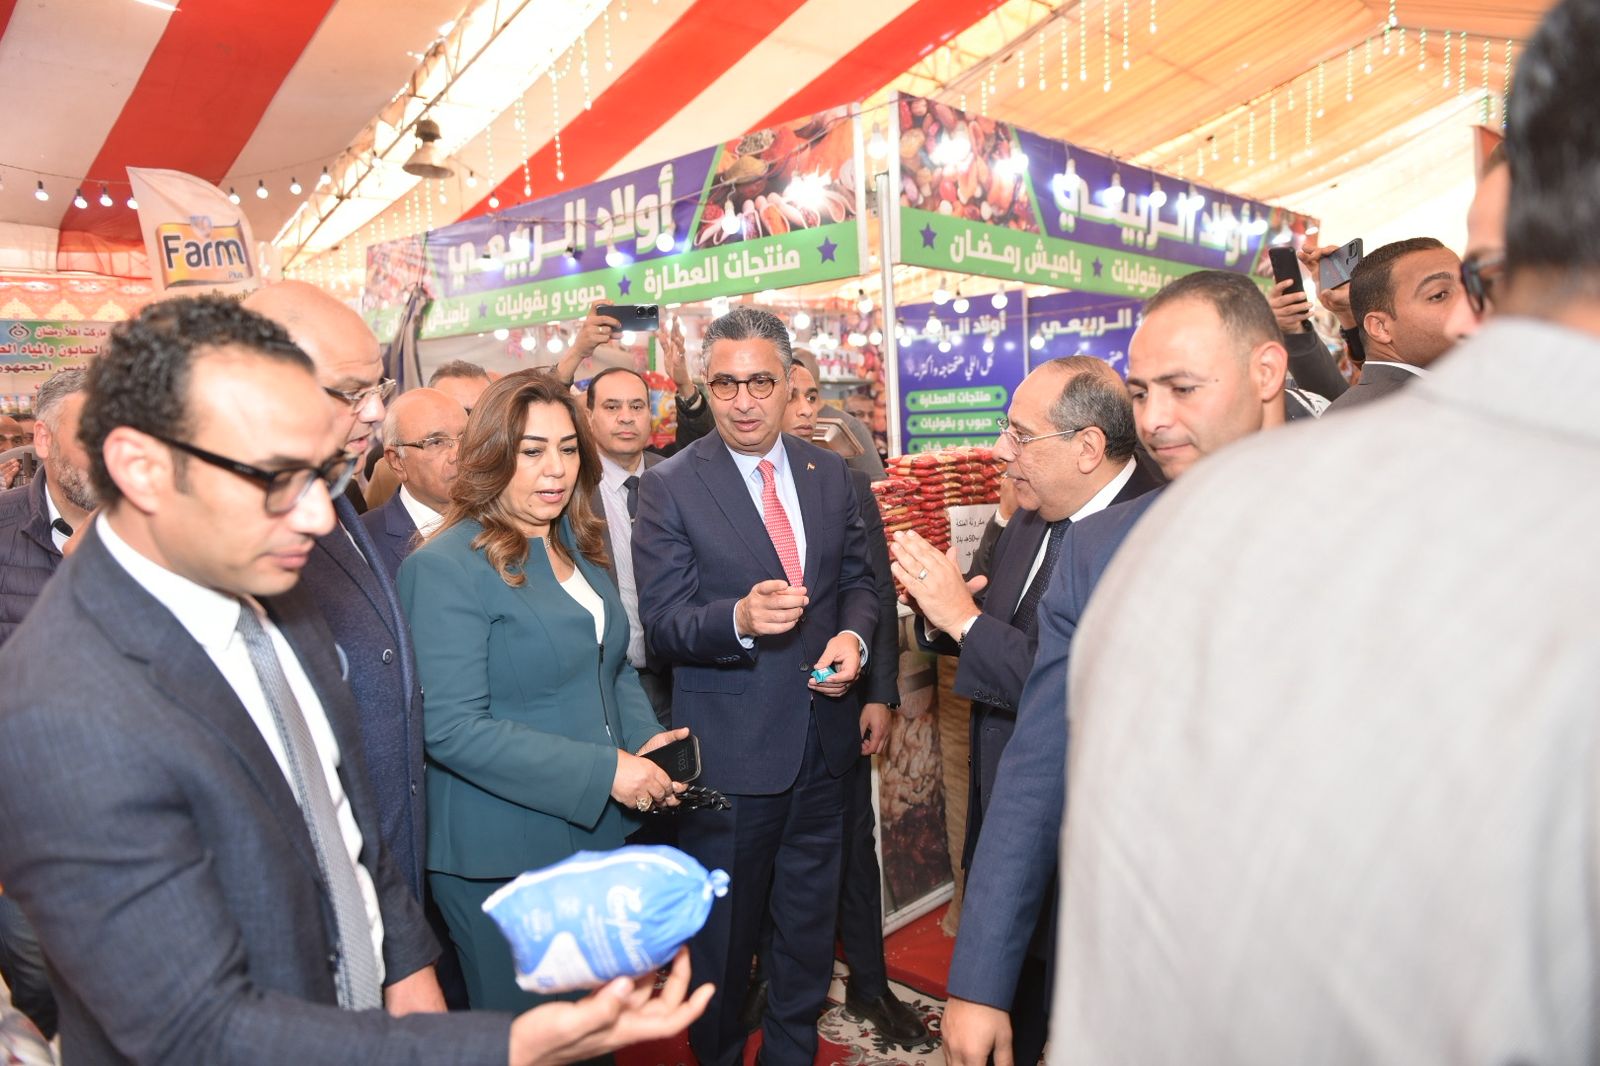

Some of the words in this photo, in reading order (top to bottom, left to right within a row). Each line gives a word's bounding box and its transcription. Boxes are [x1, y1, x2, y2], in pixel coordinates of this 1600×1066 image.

[595, 163, 674, 254] أولاد
[162, 234, 245, 269] Farm
[723, 243, 801, 285] منتجات
[949, 227, 1022, 272] رمضان
[1024, 239, 1083, 280] ياميش
[643, 255, 719, 300] العطارة
[494, 290, 549, 321] بقوليات
[551, 296, 562, 315] و
[1040, 308, 1132, 341] الربيعي
[919, 391, 955, 408] العطارة
[956, 390, 991, 407] منتجات
[920, 416, 956, 432] بقوليات
[957, 418, 965, 431] و
[966, 417, 992, 431] حبوب
